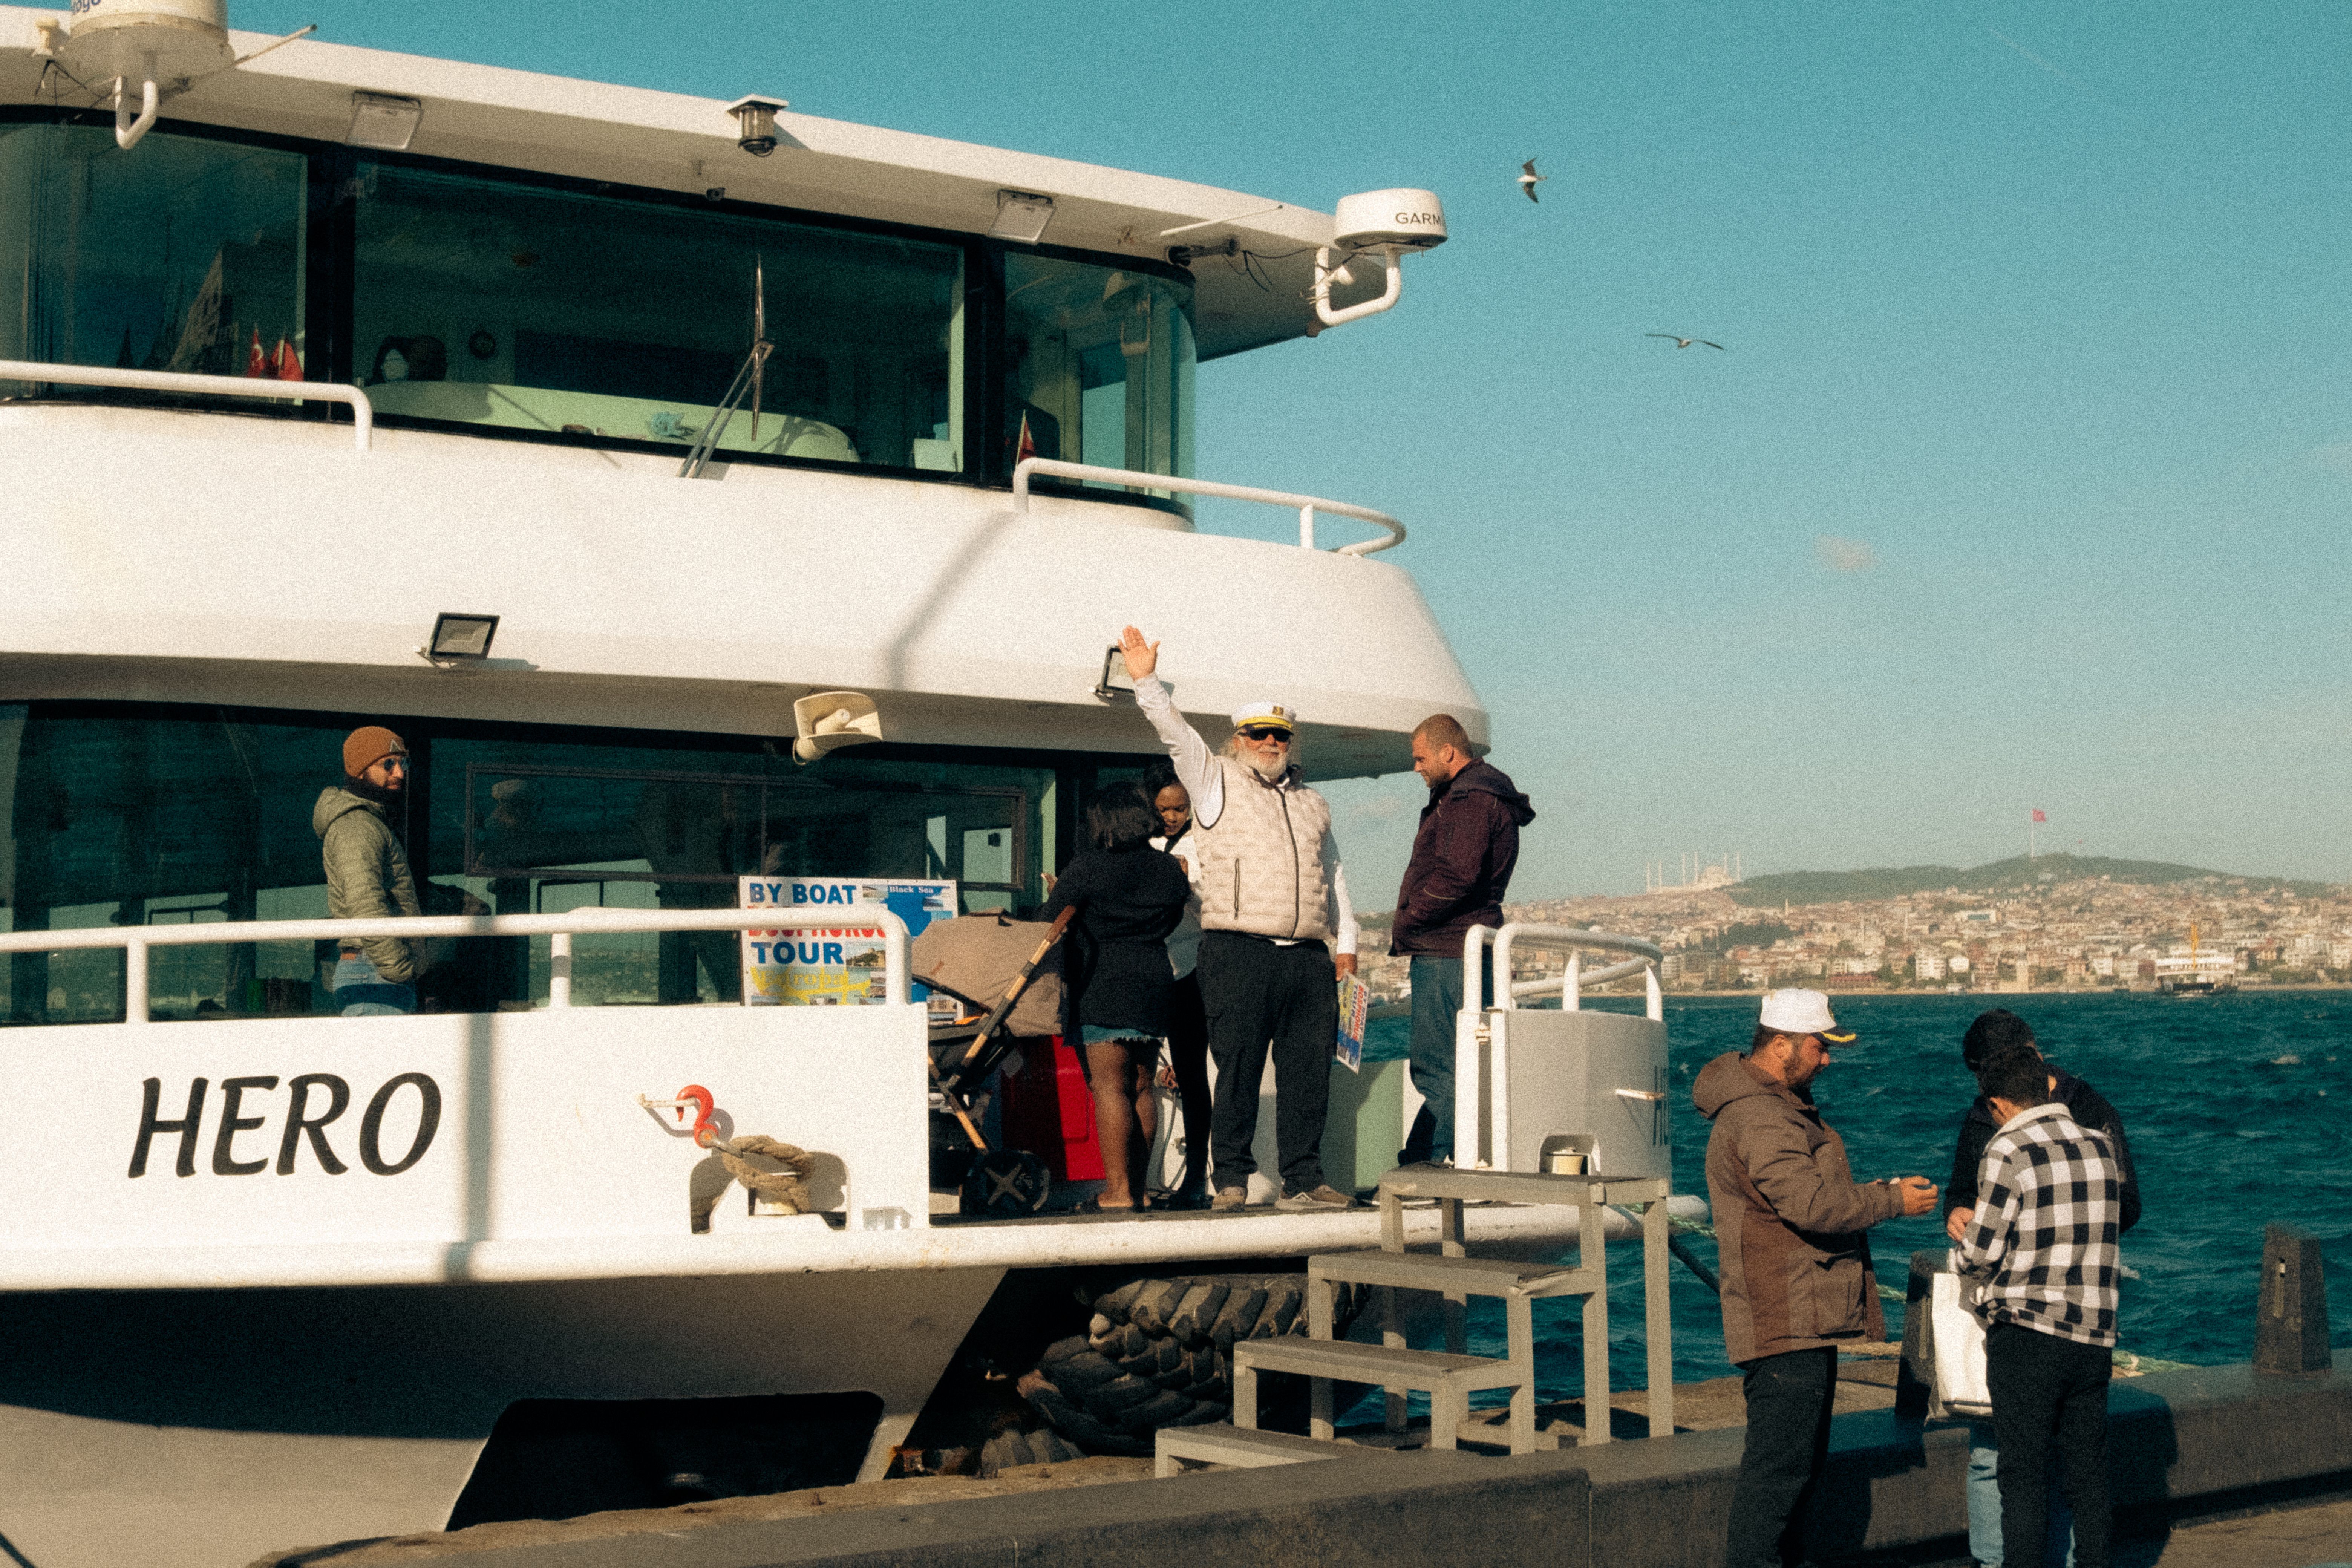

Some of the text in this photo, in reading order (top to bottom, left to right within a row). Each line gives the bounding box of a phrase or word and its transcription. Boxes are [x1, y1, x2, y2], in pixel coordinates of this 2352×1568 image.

[750, 883, 856, 904] BY BOAT
[751, 942, 844, 964] TOUR
[127, 1072, 442, 1178] HERO
